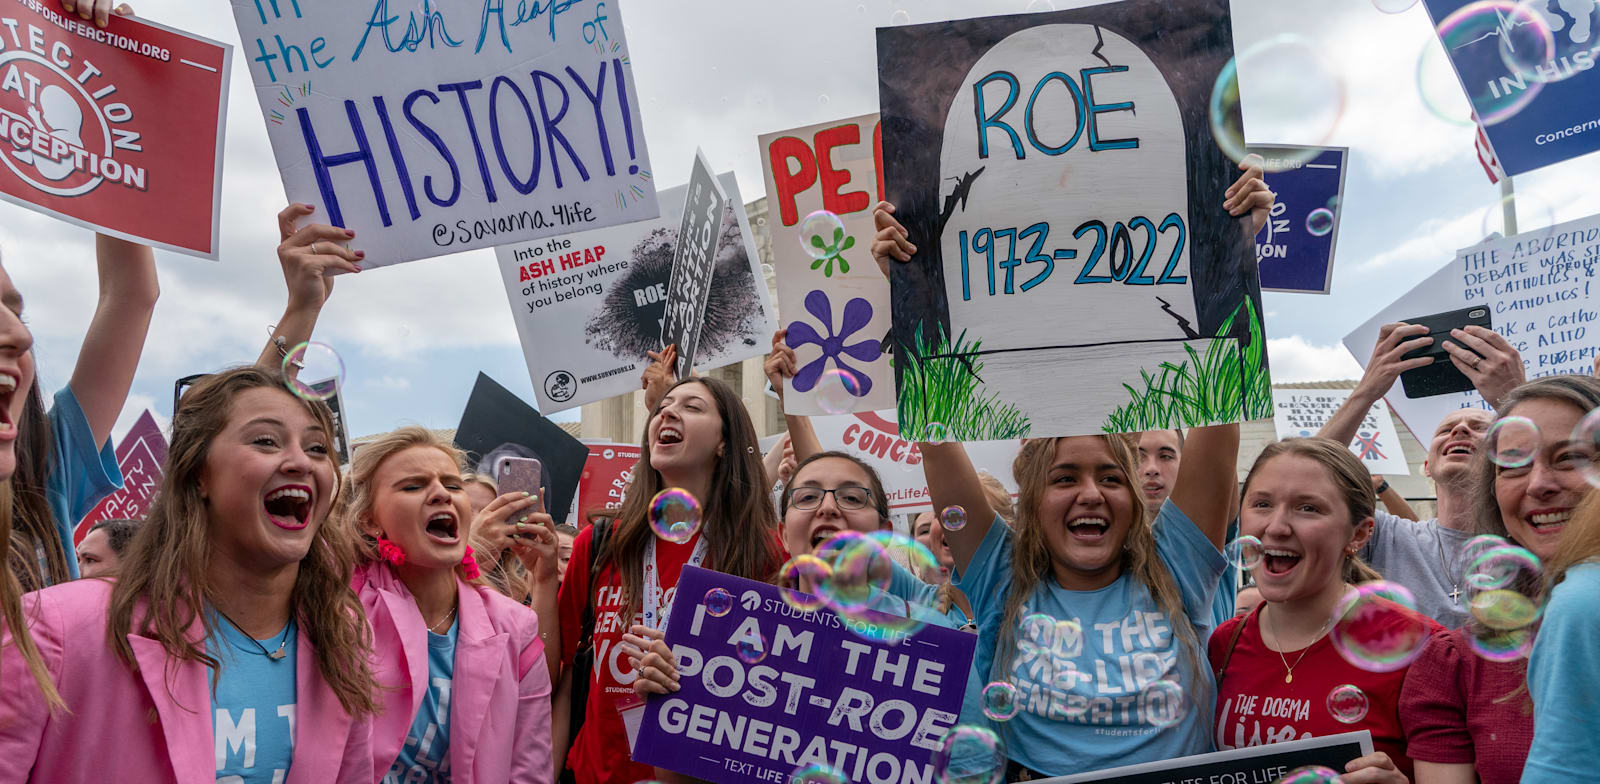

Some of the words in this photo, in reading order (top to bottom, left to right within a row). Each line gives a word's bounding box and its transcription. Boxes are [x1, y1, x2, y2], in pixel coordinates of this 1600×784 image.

[17, 0, 170, 60] TSFORLIFEACTION.ORG
[255, 34, 335, 83] the
[352, 0, 464, 62] Ash
[582, 2, 608, 44] of
[0, 17, 142, 152] TECTION
[2, 64, 41, 107] AT
[1488, 72, 1527, 99] IN
[973, 65, 1140, 160] ROE
[296, 59, 640, 228] HISTORY!
[432, 201, 597, 247] @savanna.4life
[514, 247, 543, 262] Into
[547, 238, 571, 252] the
[519, 258, 555, 283] ASH
[559, 245, 606, 271] HEAP
[959, 212, 1188, 301] 1973-2022
[1462, 250, 1500, 271] THE
[1464, 261, 1528, 286] DEBATE
[1540, 250, 1575, 268] WAS
[522, 281, 537, 296] of
[539, 273, 584, 291] history
[587, 260, 628, 278] where
[527, 297, 552, 313] you
[555, 283, 603, 303] belong
[633, 283, 667, 307] ROE
[1465, 287, 1484, 300] BY
[1538, 327, 1586, 347] ALITO
[138, 474, 155, 500] IN
[763, 599, 841, 629] STUDENTS
[845, 618, 877, 637] FOR
[882, 627, 914, 647] LIFE
[1094, 610, 1173, 655] THE
[689, 603, 707, 637] I
[727, 616, 815, 664] AM
[841, 639, 946, 696] THE
[673, 644, 958, 752] POST-ROE
[1234, 693, 1258, 715] THE
[1261, 696, 1310, 722] DOGMA
[658, 698, 936, 784] GENERATION
[724, 757, 754, 776] TEXT
[756, 767, 784, 784] LIFE
